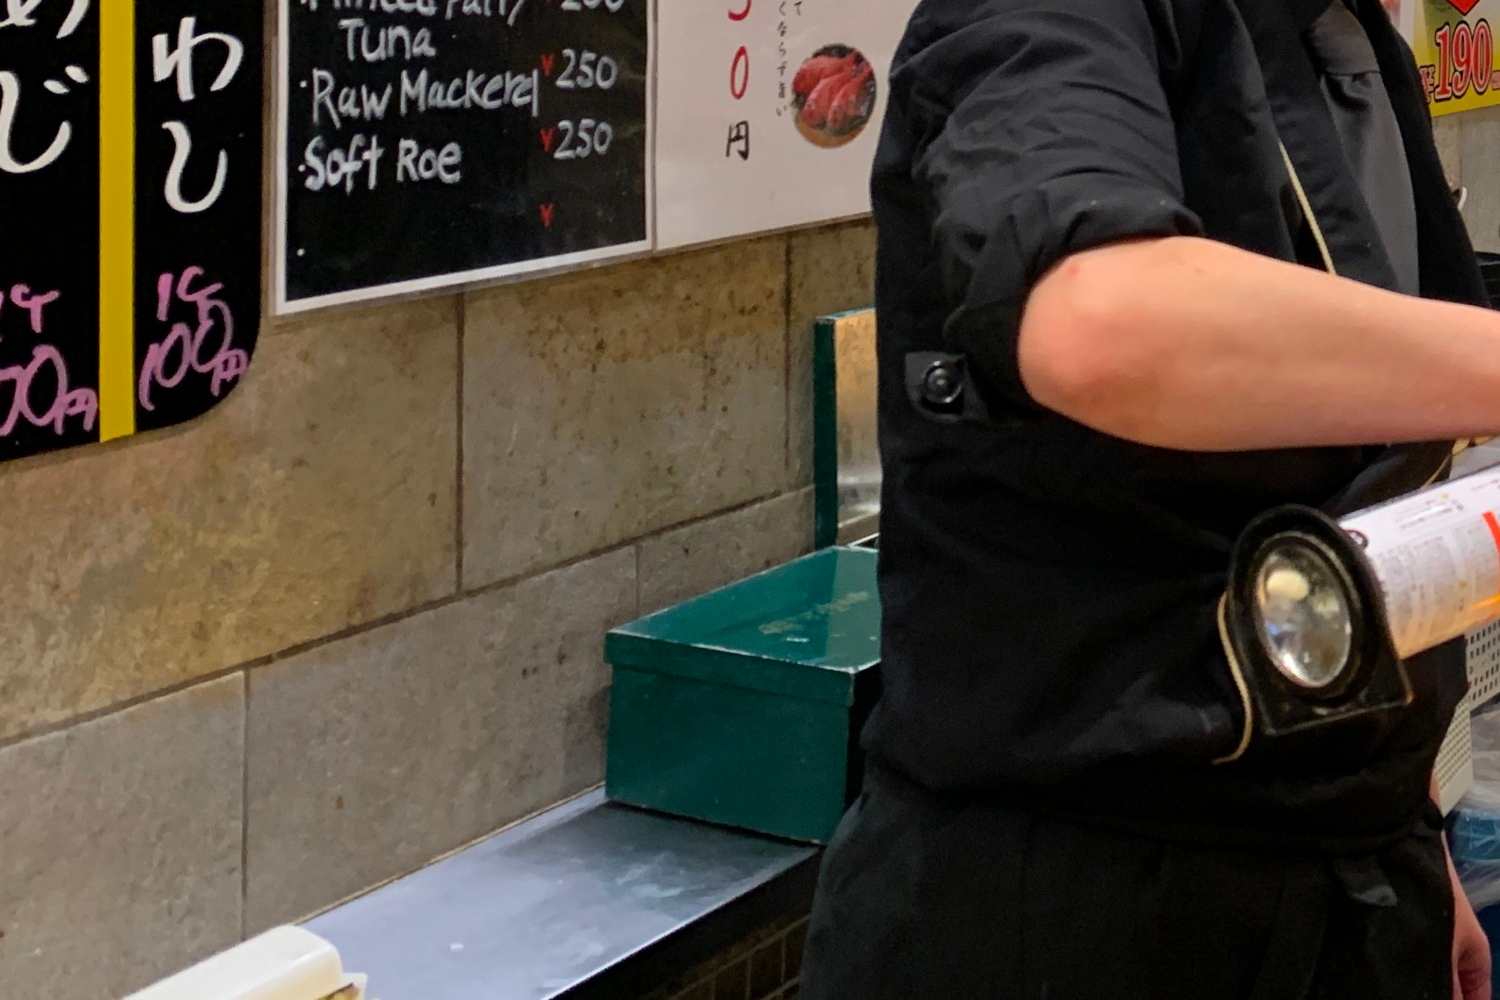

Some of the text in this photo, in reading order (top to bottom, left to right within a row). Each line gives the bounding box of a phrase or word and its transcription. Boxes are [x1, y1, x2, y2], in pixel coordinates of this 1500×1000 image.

[339, 18, 437, 62] Tuna
[311, 68, 392, 128] Raw
[304, 134, 384, 196] Soft
[396, 137, 462, 184] Roe
